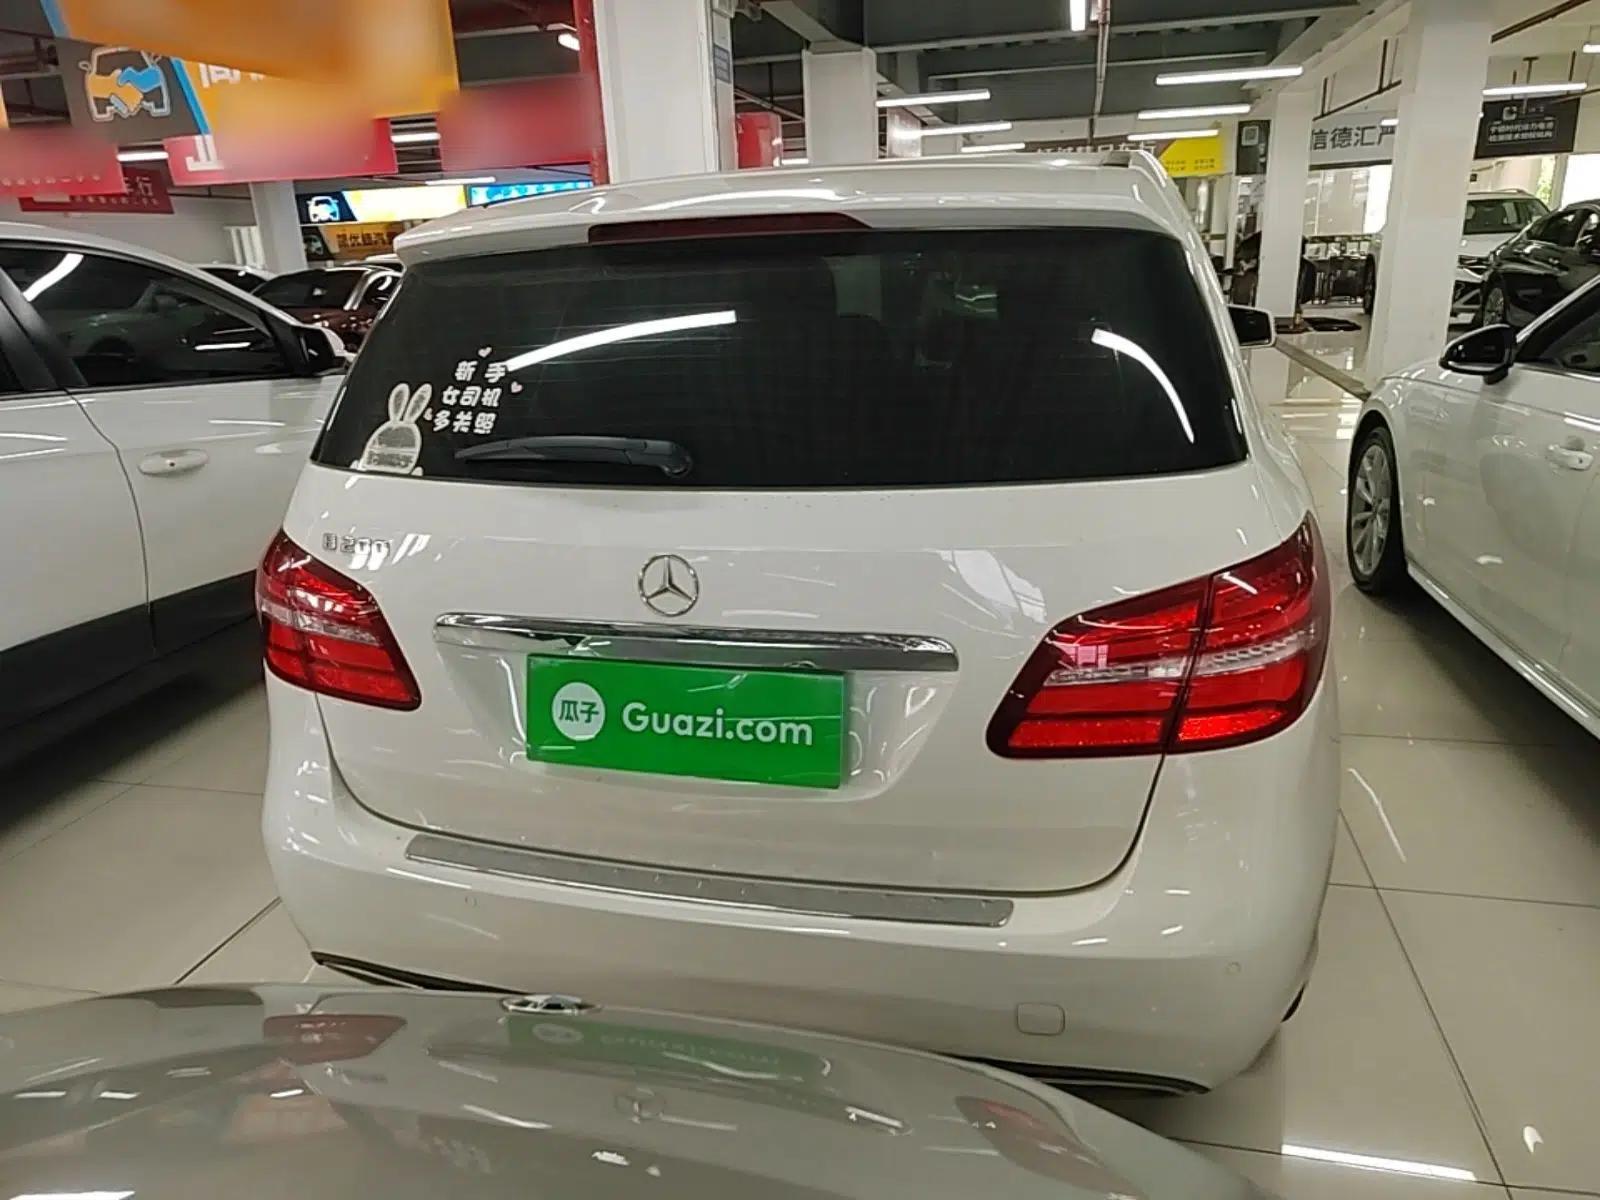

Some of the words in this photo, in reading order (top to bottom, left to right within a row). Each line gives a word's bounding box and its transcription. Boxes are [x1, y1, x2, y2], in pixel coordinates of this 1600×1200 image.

[454, 360, 508, 383] 新手
[441, 386, 502, 408] 女司机
[432, 410, 497, 435] 多关照
[558, 699, 600, 724] 瓜子
[621, 701, 814, 747] Guazi.com
